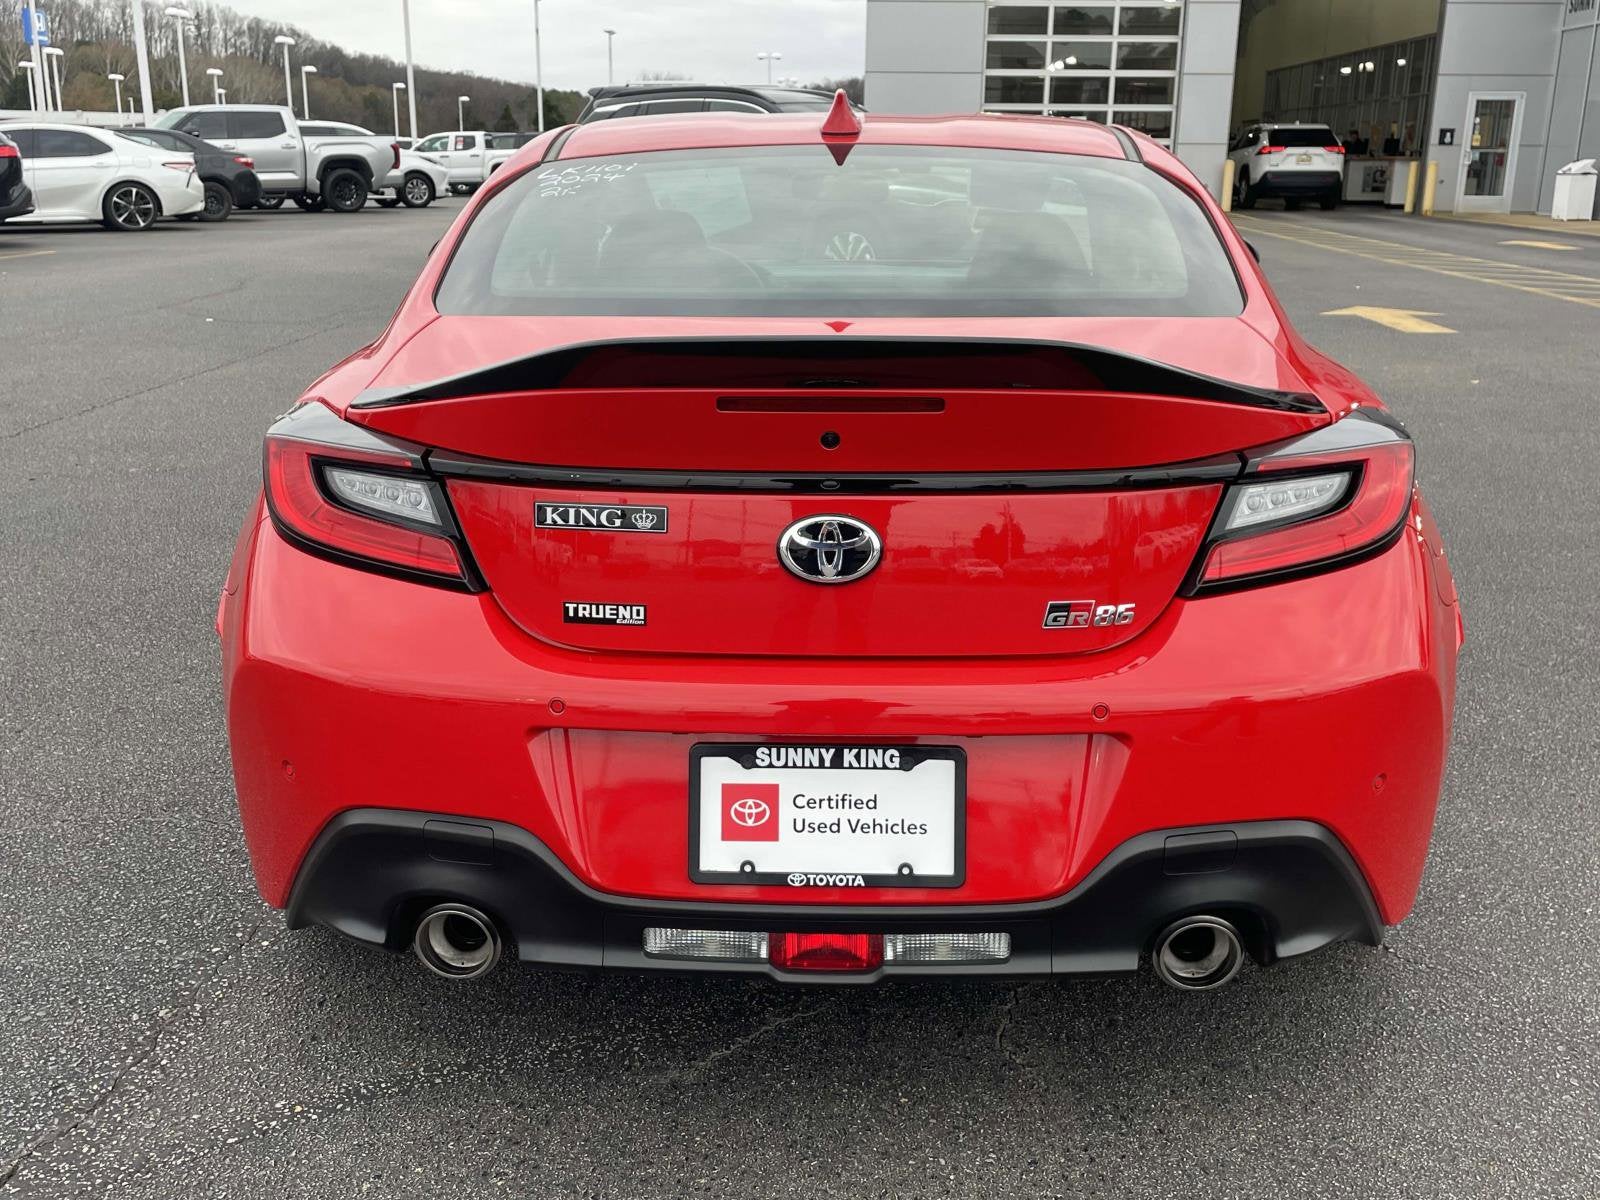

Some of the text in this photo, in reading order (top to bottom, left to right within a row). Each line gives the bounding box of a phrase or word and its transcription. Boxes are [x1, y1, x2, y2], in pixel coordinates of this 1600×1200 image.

[544, 506, 623, 528] KING
[565, 603, 645, 620] TRUENO
[1093, 603, 1136, 627] 86
[755, 747, 900, 769] SUNNY KING
[792, 793, 878, 810] Certified
[792, 817, 928, 835] Used Vehicles
[807, 873, 865, 887] TOYOTA
